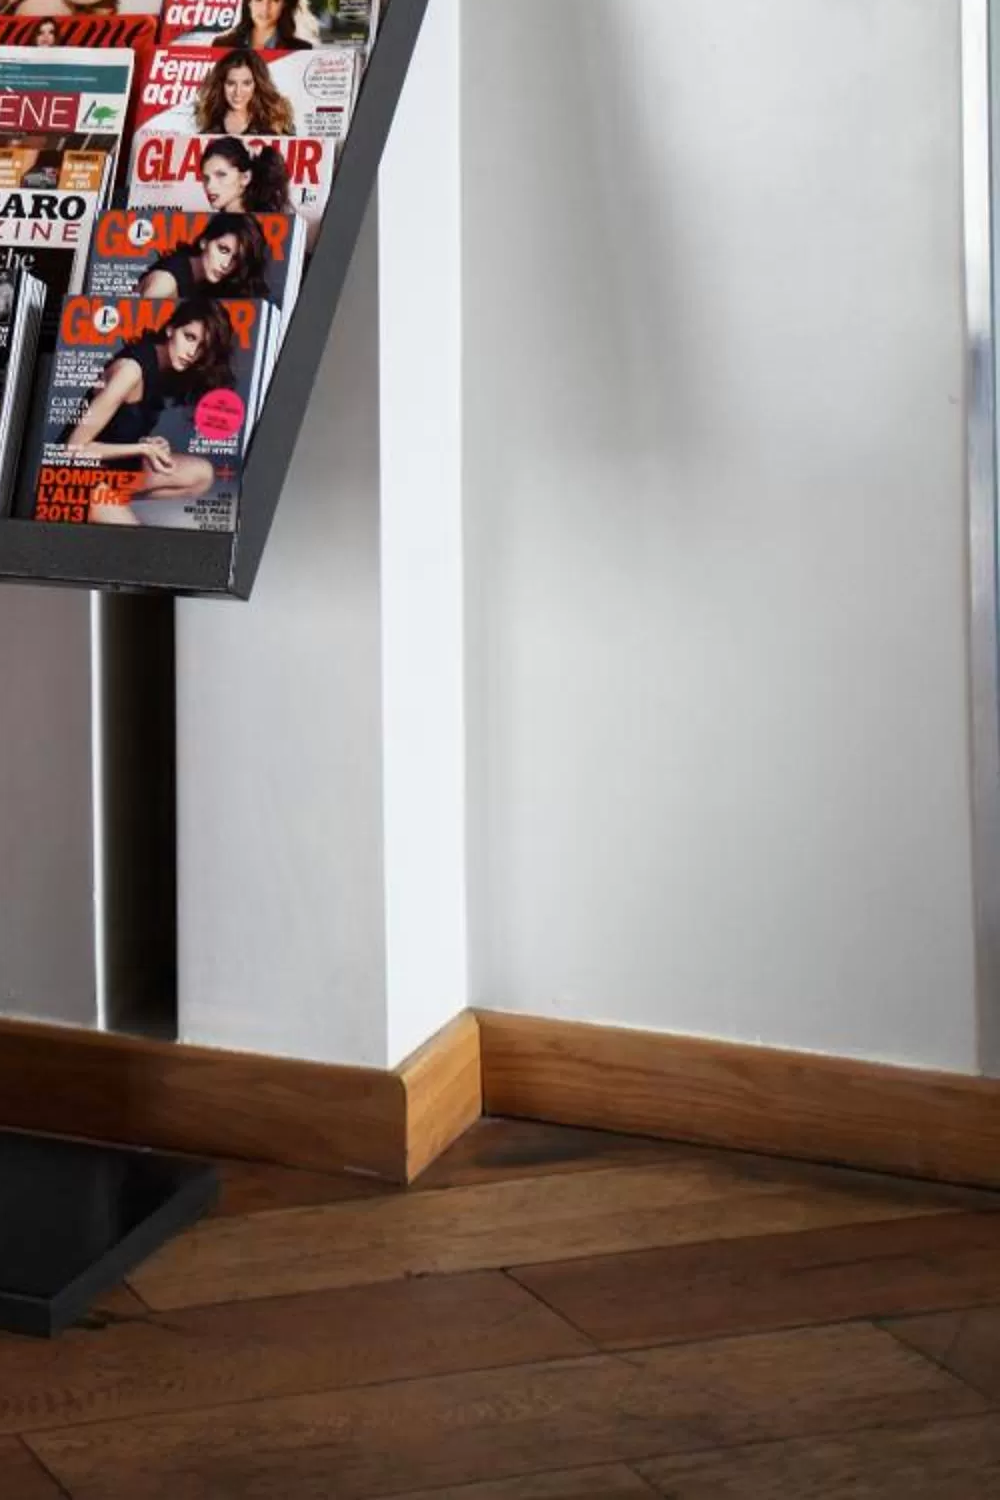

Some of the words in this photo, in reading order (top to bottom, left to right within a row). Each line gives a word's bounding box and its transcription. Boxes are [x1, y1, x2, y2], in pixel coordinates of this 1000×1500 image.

[165, 1, 242, 28] actuel
[149, 49, 216, 81] Fem
[137, 137, 323, 185] GLAUR
[96, 211, 289, 260] GLAMR
[61, 296, 256, 348] GLAMR
[41, 468, 137, 486] DOMPTEZ
[36, 504, 84, 522] 2013
